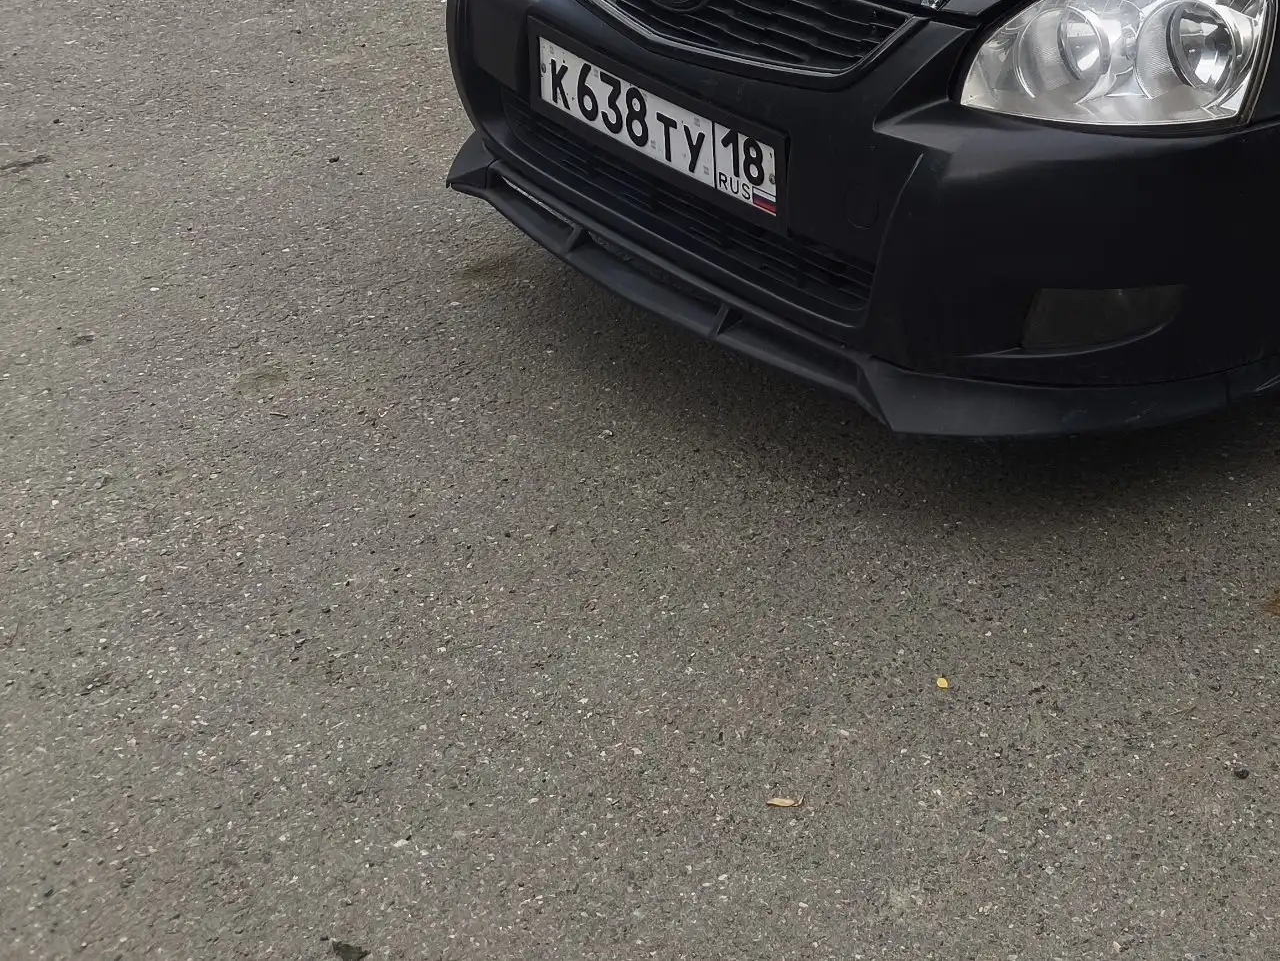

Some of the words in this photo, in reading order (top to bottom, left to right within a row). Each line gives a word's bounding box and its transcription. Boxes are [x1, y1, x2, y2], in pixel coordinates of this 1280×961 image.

[549, 58, 706, 174] К638ТУ
[721, 128, 765, 187] 18
[718, 171, 751, 201] RUS
